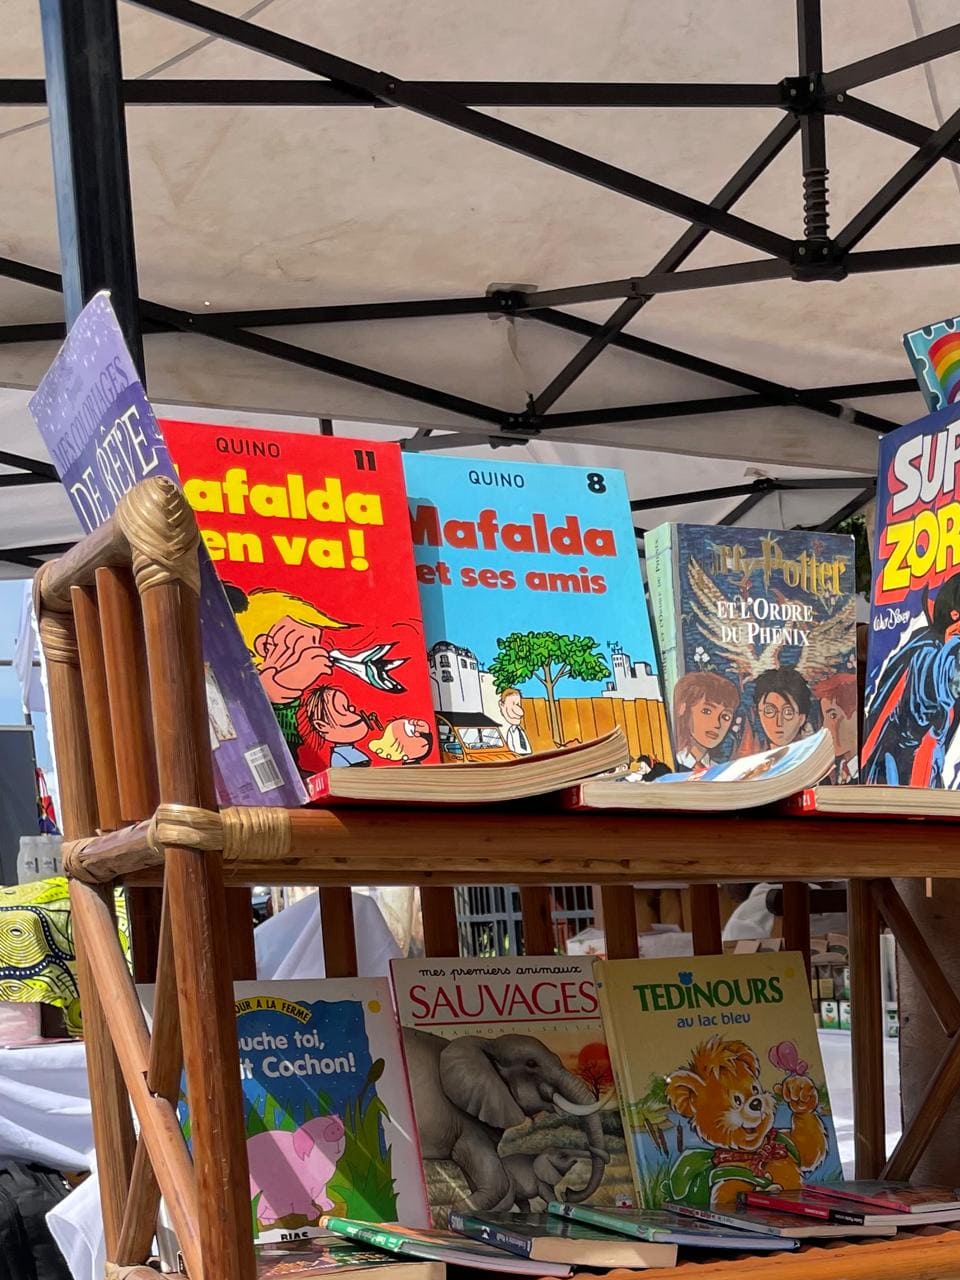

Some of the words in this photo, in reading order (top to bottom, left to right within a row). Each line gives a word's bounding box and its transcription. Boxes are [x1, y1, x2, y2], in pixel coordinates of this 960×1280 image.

[216, 437, 280, 458] QUINO
[354, 449, 377, 471] 11
[468, 470, 526, 489] QUINO
[586, 472, 608, 494] 8
[174, 464, 385, 526] afalda
[407, 503, 618, 558] Mafalda
[272, 528, 370, 572] va!
[416, 561, 452, 586] et
[459, 566, 517, 590] ses
[524, 566, 608, 595] amis
[717, 601, 737, 619] ET
[721, 625, 743, 644] DU
[418, 968, 446, 977] mes
[450, 964, 511, 982] premiers
[515, 965, 582, 976] animaux
[408, 980, 600, 1020] SAUVAGES
[281, 1001, 311, 1024] FERME
[676, 1014, 694, 1028] au
[721, 1011, 752, 1026] bleu
[293, 1029, 326, 1051] toi,
[262, 1052, 357, 1079] Cochon!
